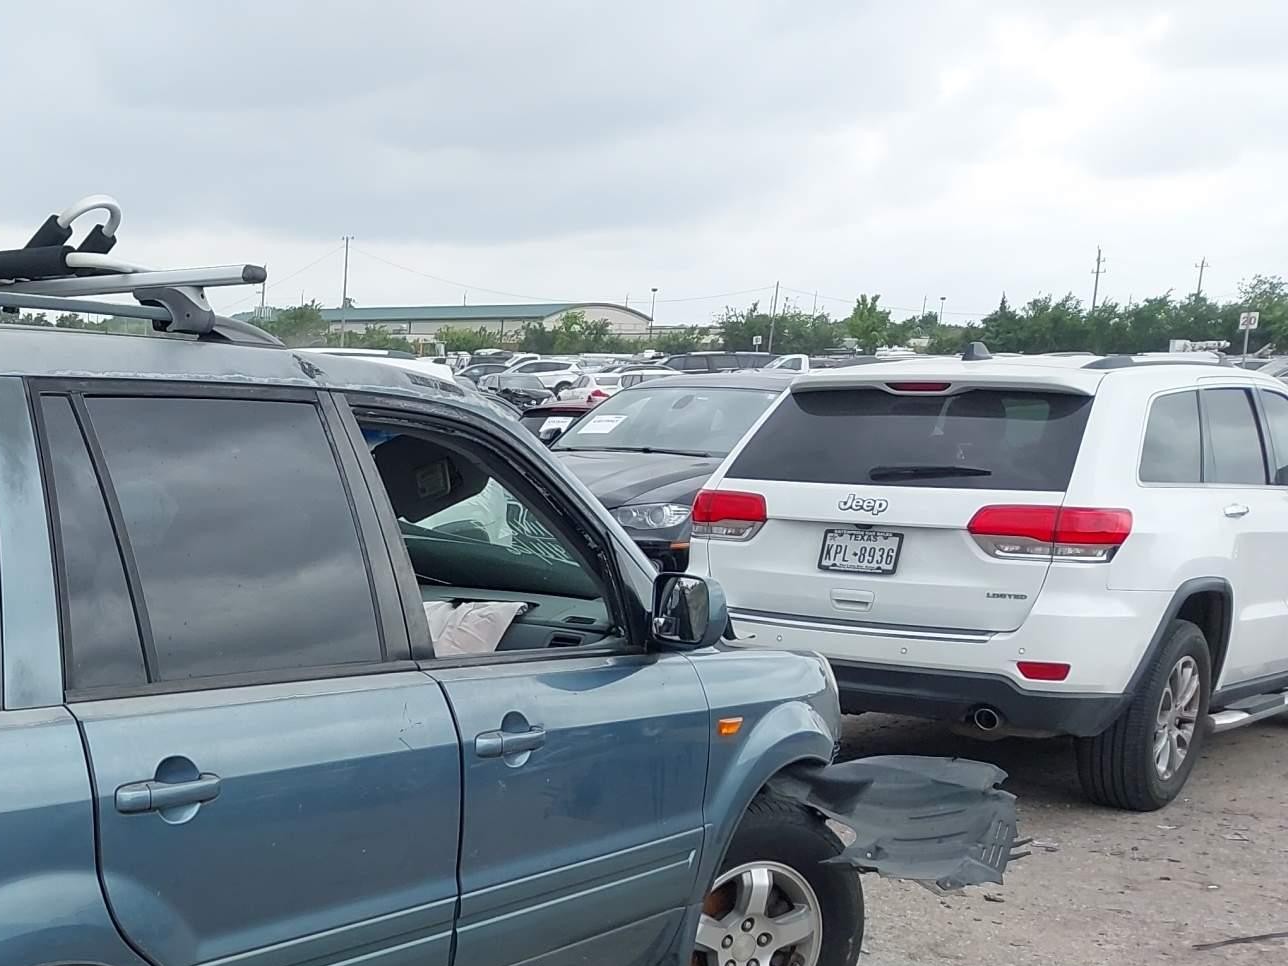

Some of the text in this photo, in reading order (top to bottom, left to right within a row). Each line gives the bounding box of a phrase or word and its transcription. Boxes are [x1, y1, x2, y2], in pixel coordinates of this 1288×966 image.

[1241, 316, 1257, 326] 20
[838, 493, 888, 516] Jeep
[848, 533, 878, 543] TEXAS
[824, 543, 895, 565] KPL 8936
